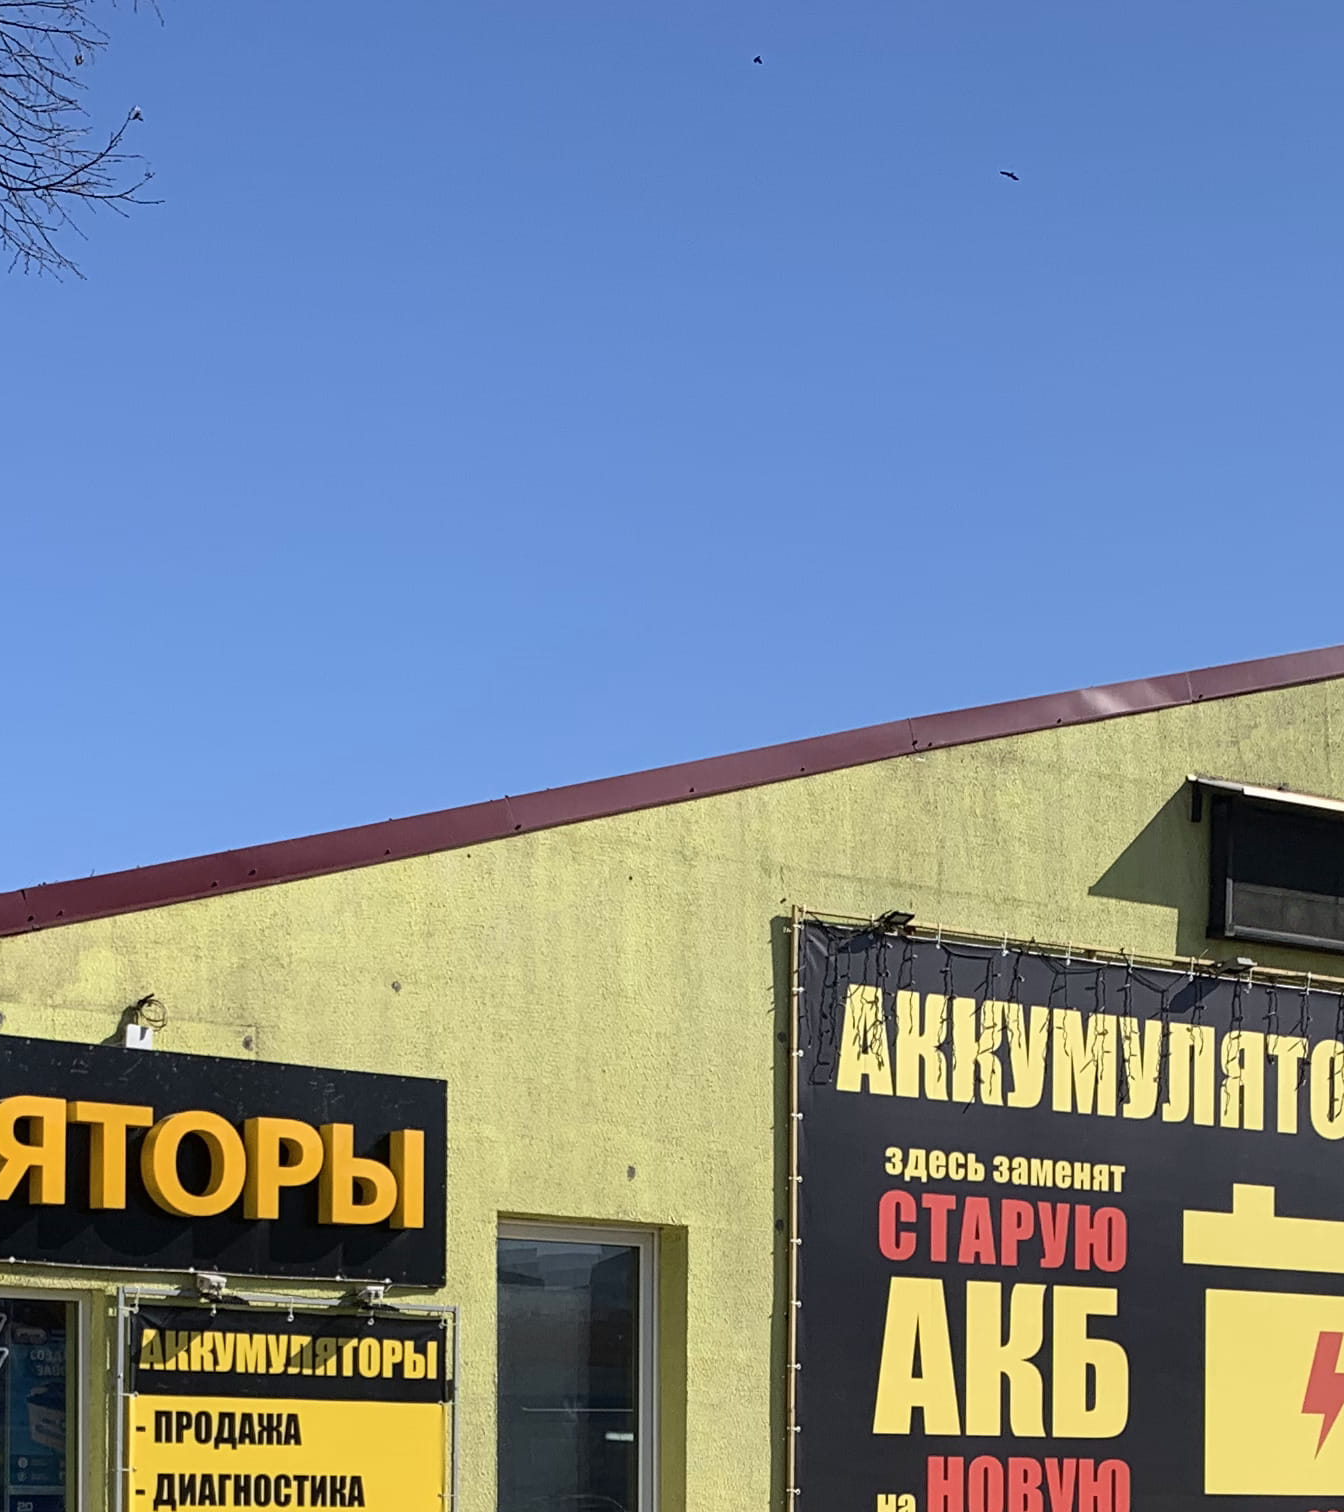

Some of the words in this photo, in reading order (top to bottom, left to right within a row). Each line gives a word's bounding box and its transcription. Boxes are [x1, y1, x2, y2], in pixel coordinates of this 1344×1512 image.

[884, 1147, 986, 1184] здесь
[993, 1155, 1126, 1193] заменят
[878, 1189, 1127, 1273] СТАРУЮ
[138, 1327, 439, 1381] АККУМУЛЯТОРЫ
[872, 1276, 1131, 1439] АКБ
[153, 1410, 302, 1449] ПРОДАЖА
[152, 1473, 365, 1511] ДИАГНОСТИКА
